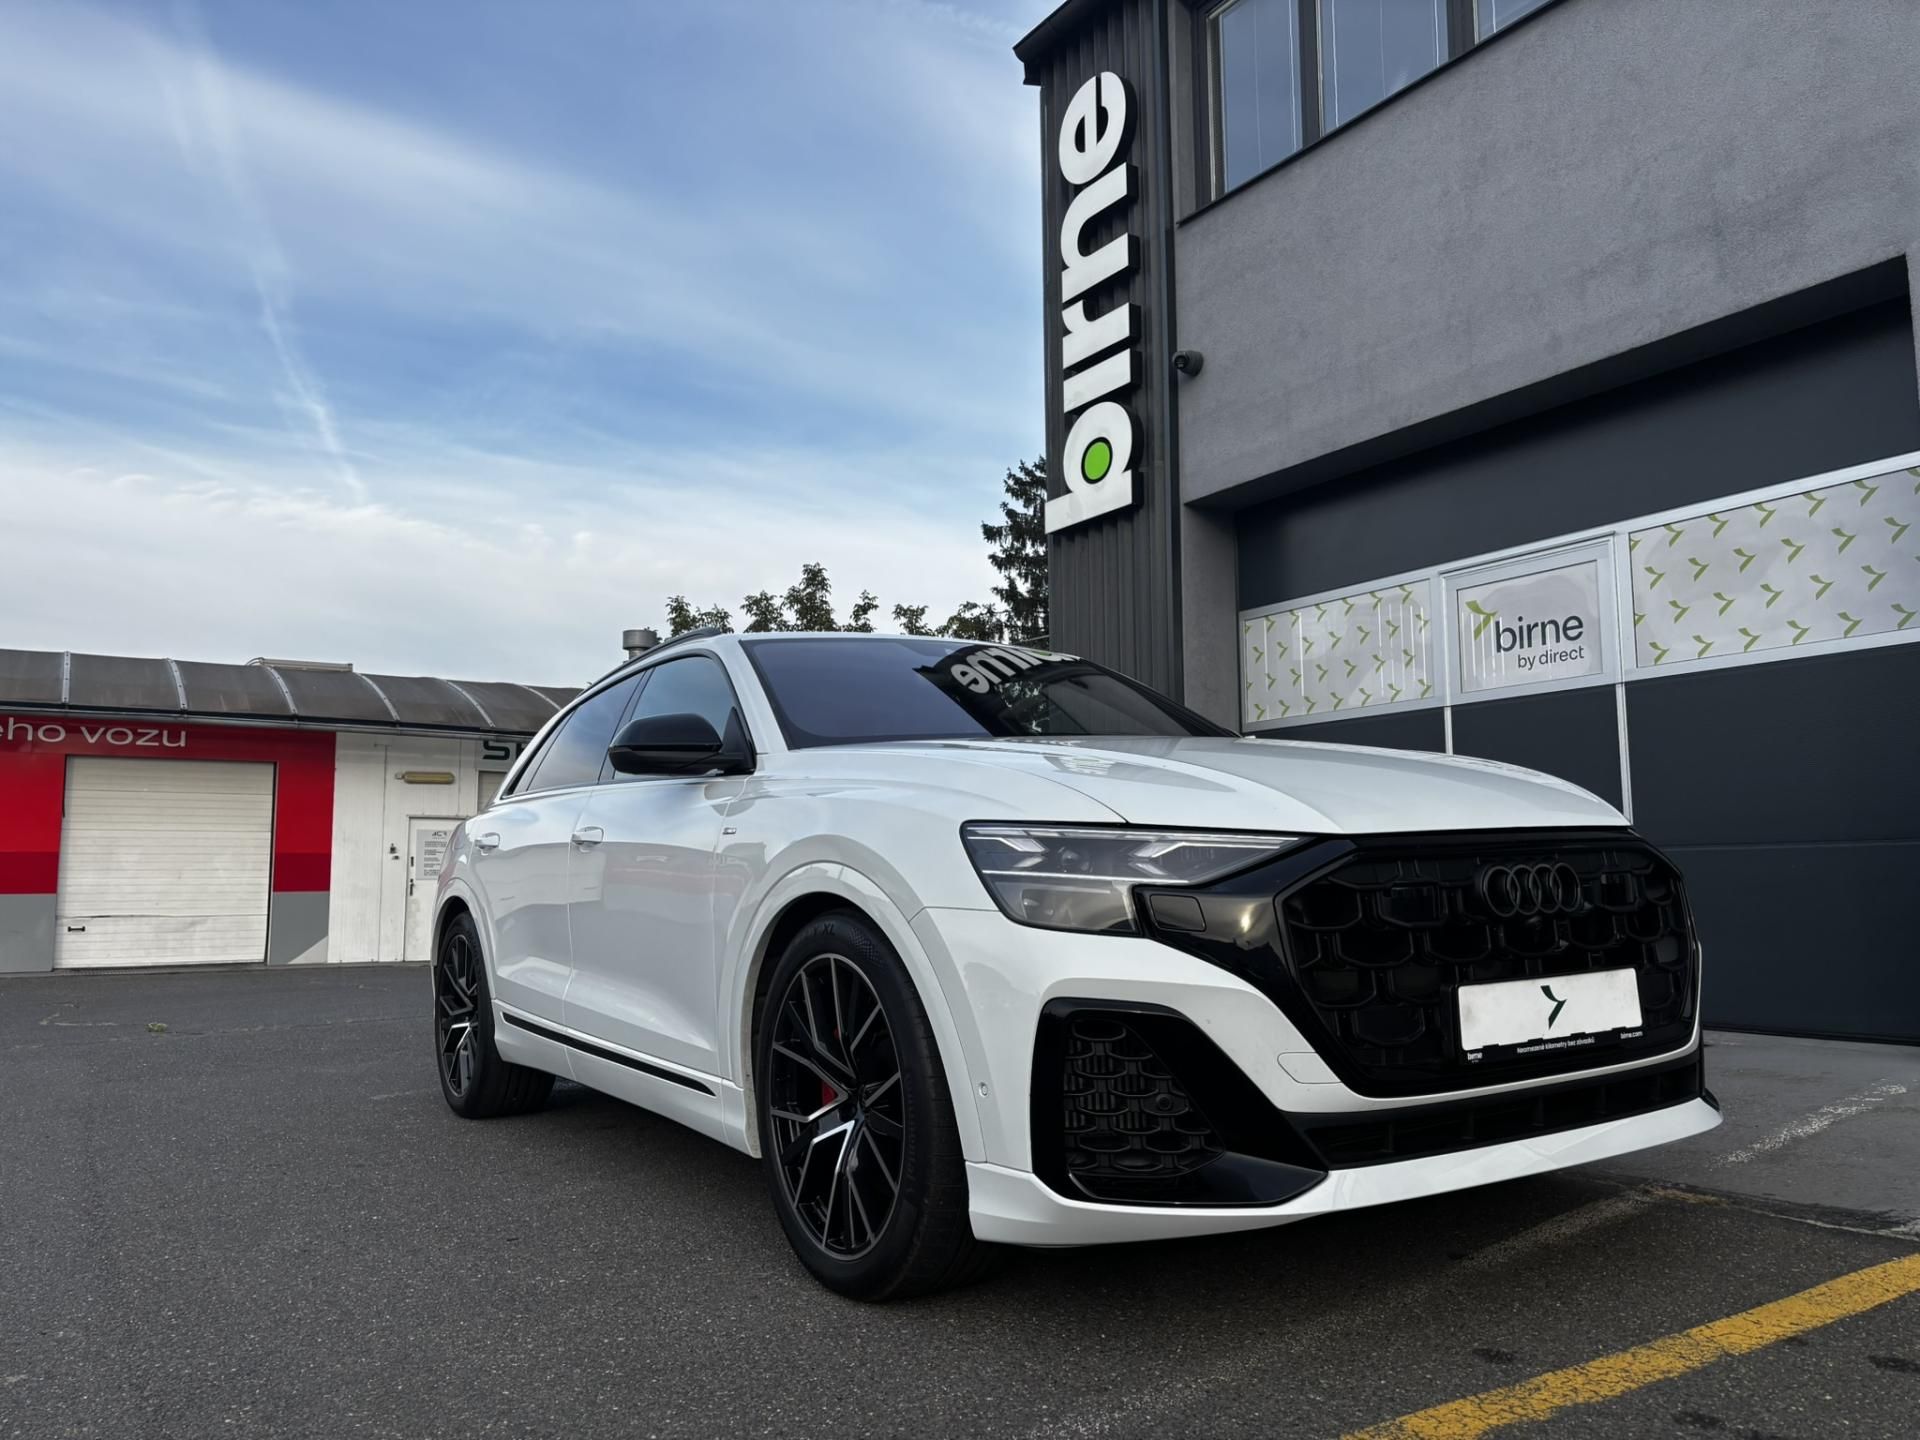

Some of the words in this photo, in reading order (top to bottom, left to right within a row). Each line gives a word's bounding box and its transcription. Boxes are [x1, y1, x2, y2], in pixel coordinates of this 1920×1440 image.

[1045, 71, 1133, 534] birne
[1495, 615, 1584, 653] birne
[1518, 654, 1536, 671] by
[1539, 645, 1584, 665] direct
[0, 717, 66, 743] ho
[80, 726, 187, 747] vozu
